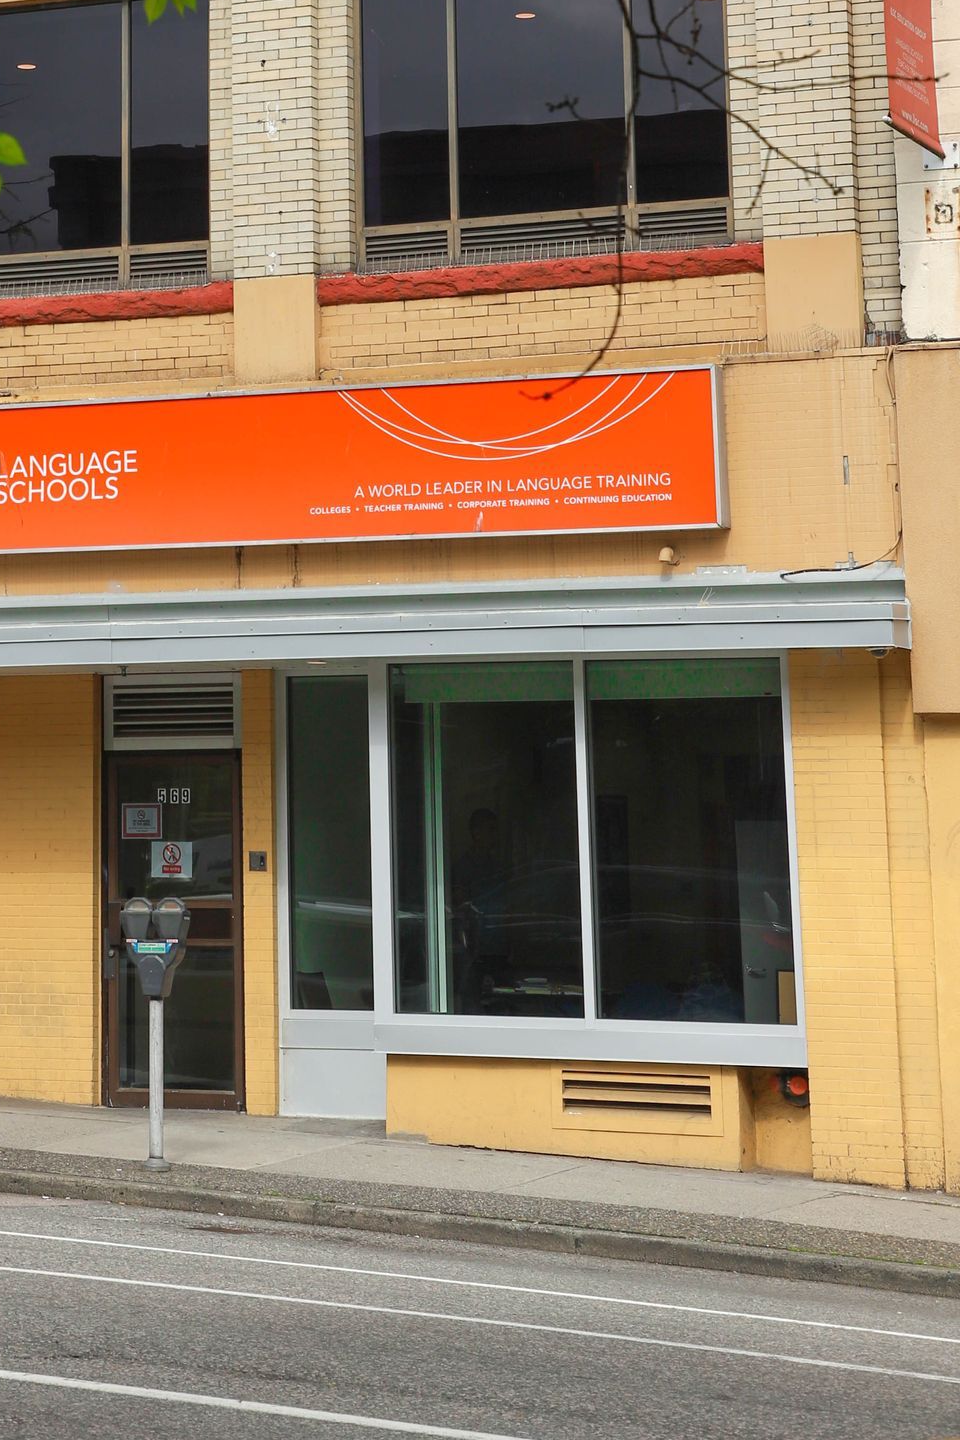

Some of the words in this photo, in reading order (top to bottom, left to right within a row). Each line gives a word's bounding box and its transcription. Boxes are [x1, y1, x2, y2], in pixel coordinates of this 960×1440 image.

[353, 485, 365, 499] A
[368, 483, 422, 498] WORLD
[426, 480, 482, 496] LEADER
[487, 479, 502, 493] IN
[507, 475, 592, 492] LANGUAGE
[596, 472, 672, 489] TRAINING
[309, 505, 351, 515] COLLEGES
[364, 504, 402, 513] TEACHER
[404, 502, 444, 511] TRAINING
[457, 499, 507, 509] CORPORATE
[509, 497, 550, 507] TRAINING
[563, 495, 619, 505] CONTINUING
[621, 493, 672, 503] EDUCATION
[158, 788, 191, 804] 569
